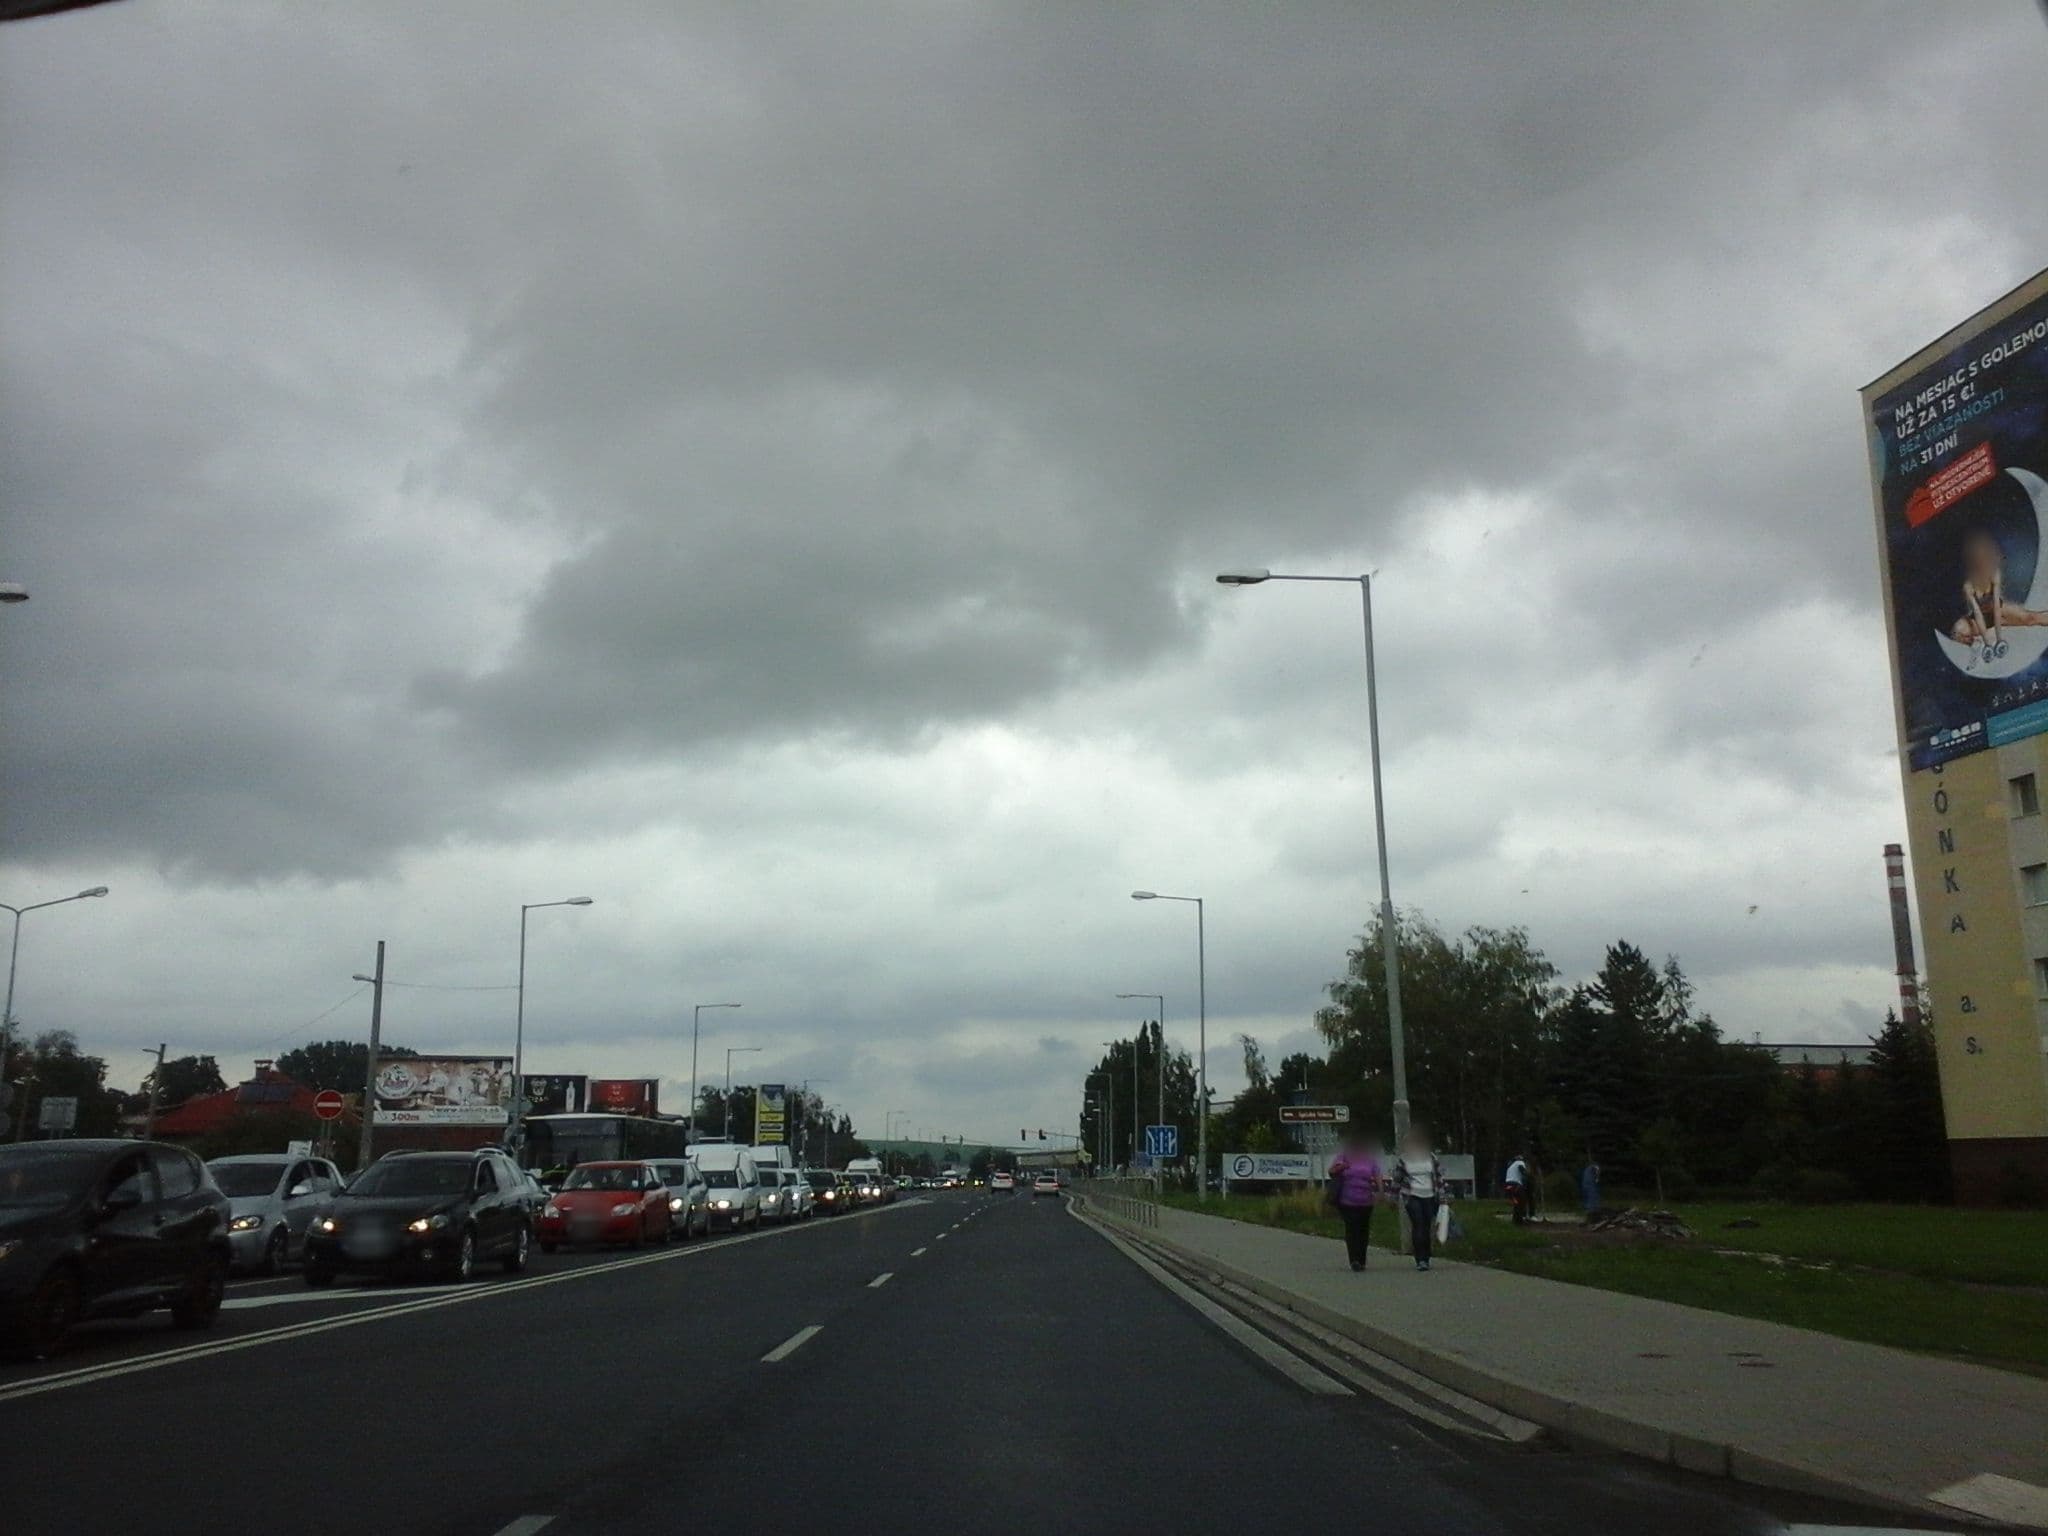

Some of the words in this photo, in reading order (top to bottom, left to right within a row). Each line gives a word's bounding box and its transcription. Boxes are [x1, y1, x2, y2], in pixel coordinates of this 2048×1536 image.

[1895, 401, 1914, 422] NA
[1916, 369, 1966, 409] MESIAC
[1969, 361, 1978, 377] S
[1896, 417, 1915, 439] UŽ
[1918, 408, 1937, 427] ZA
[1942, 394, 1957, 414] 15
[1900, 460, 1918, 476] NA
[1920, 448, 1933, 465] 31
